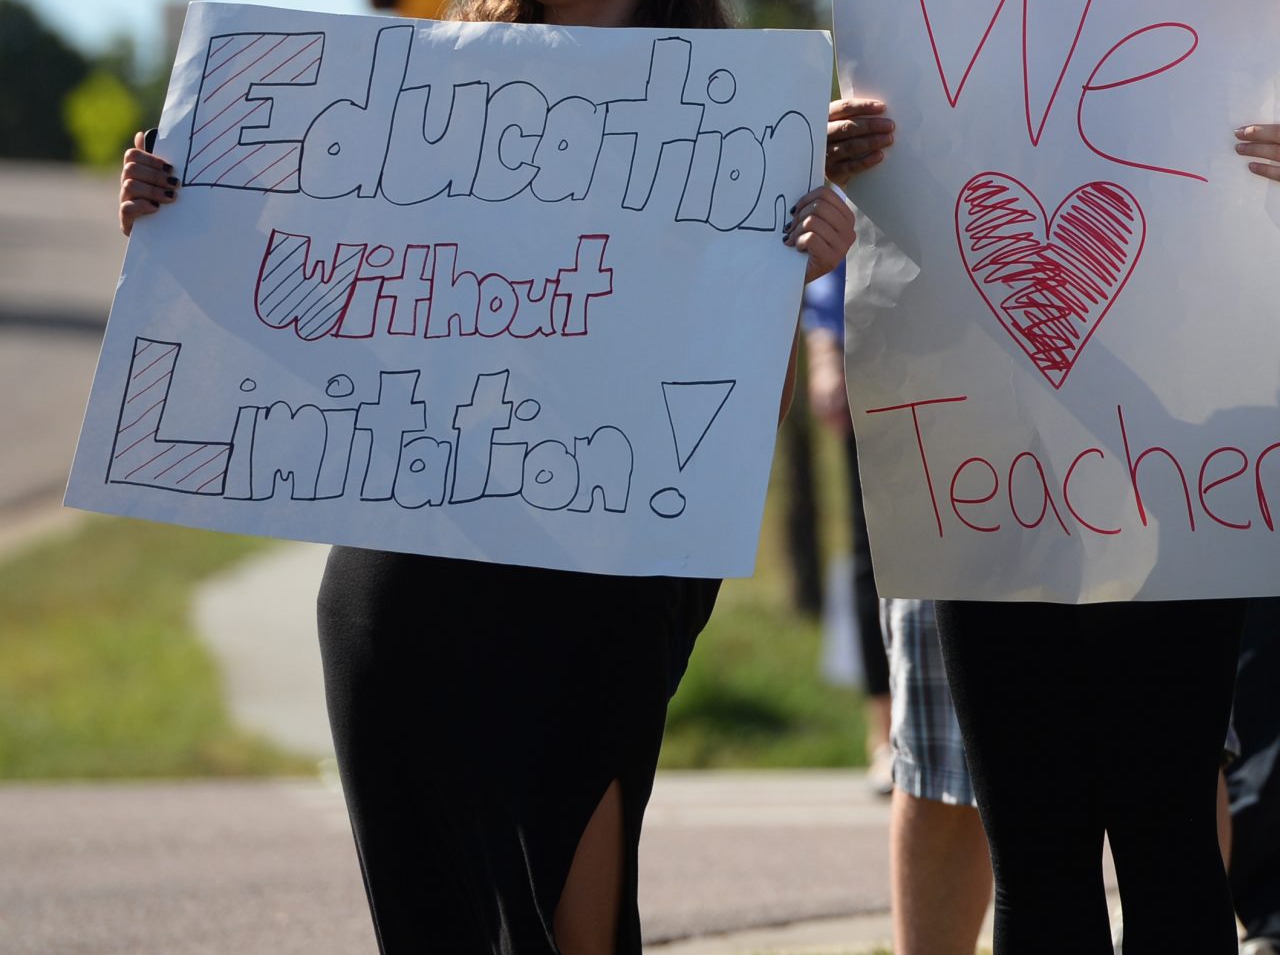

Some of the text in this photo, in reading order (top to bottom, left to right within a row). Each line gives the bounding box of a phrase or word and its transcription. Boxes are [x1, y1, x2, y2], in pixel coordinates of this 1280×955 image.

[182, 24, 815, 232] Education
[254, 228, 613, 341] Without
[105, 337, 737, 518] Limitation!
